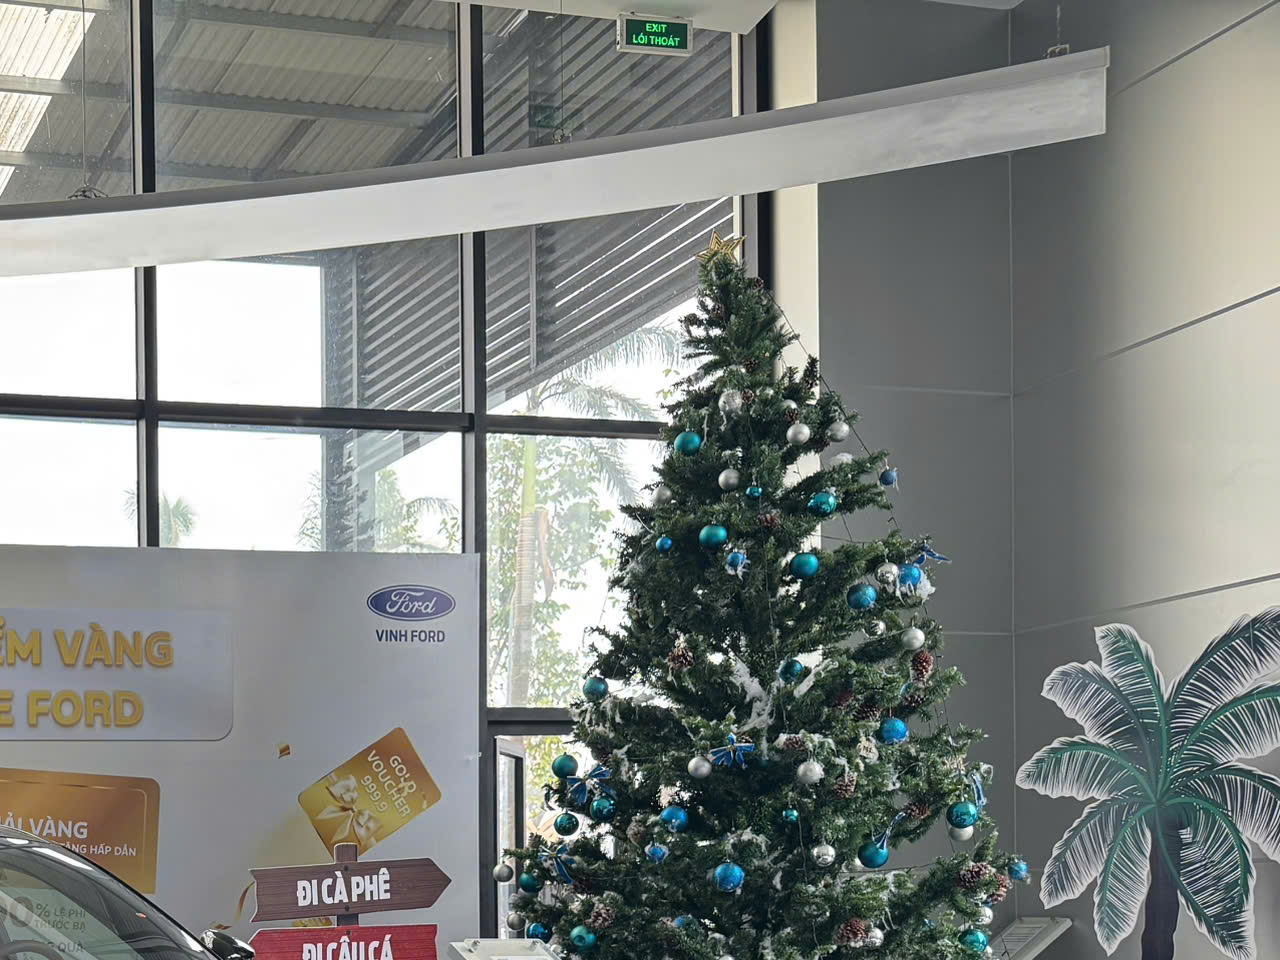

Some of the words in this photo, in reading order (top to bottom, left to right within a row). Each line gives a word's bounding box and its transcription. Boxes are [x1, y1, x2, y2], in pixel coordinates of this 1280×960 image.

[645, 23, 667, 33] EXIT
[649, 35, 680, 47] THOÁT
[53, 622, 175, 668] VÀNG
[376, 629, 408, 643] VINH
[411, 630, 446, 643] FORD
[27, 689, 145, 728] FORD
[367, 749, 411, 817] VOUCHER
[28, 815, 88, 839] VÀNG
[296, 880, 318, 906] ĐI
[321, 871, 348, 904] CÀ
[351, 867, 391, 902] PHÊ
